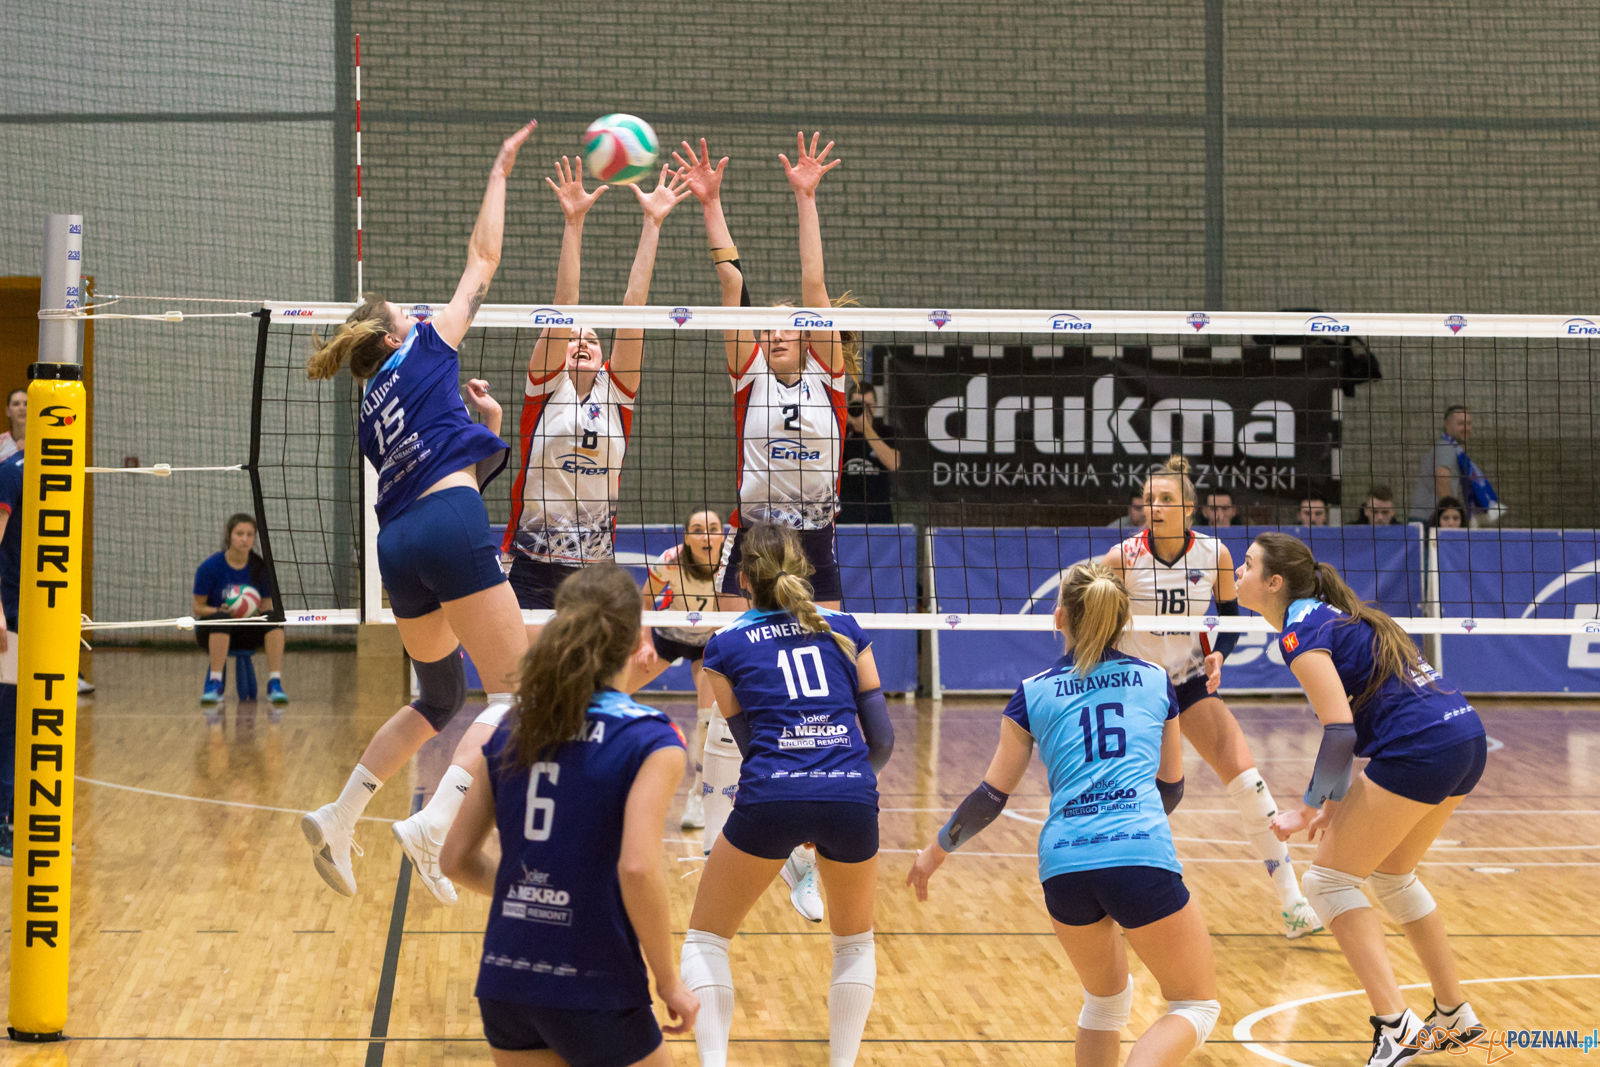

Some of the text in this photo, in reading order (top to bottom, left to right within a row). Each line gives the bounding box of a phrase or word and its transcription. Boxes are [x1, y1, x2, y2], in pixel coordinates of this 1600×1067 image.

[68, 250, 80, 260] 235
[66, 286, 79, 296] 224
[283, 308, 314, 317] netex
[534, 315, 574, 325] Enea
[793, 317, 833, 328] Enea
[1052, 321, 1092, 330] Enea
[1310, 323, 1350, 333] Enea
[782, 404, 801, 431] 2
[924, 373, 1296, 458] drukma
[373, 396, 405, 455] 15
[582, 423, 598, 450] 8
[770, 447, 820, 461] Enea
[562, 460, 608, 475] Enea
[933, 459, 1296, 490] DRUKARNIA SKZYŃSKI
[37, 438, 73, 608] SPORT
[1156, 588, 1185, 615] 16
[298, 614, 328, 622] netex
[745, 622, 826, 643] WENERS
[777, 645, 830, 700] 10
[1054, 671, 1144, 697] ŻURAWSKA
[798, 710, 830, 725] Joker
[795, 724, 848, 737] MEKRO
[1078, 702, 1127, 763] 16
[781, 737, 849, 747] ENERGO REMONT
[524, 762, 560, 841] 6
[1081, 788, 1137, 805] MEKRO
[26, 673, 65, 947] TRANSFER
[1065, 803, 1138, 817] ENERGO REMONT
[518, 886, 571, 906] MEKRO
[527, 907, 568, 922] REMONT
